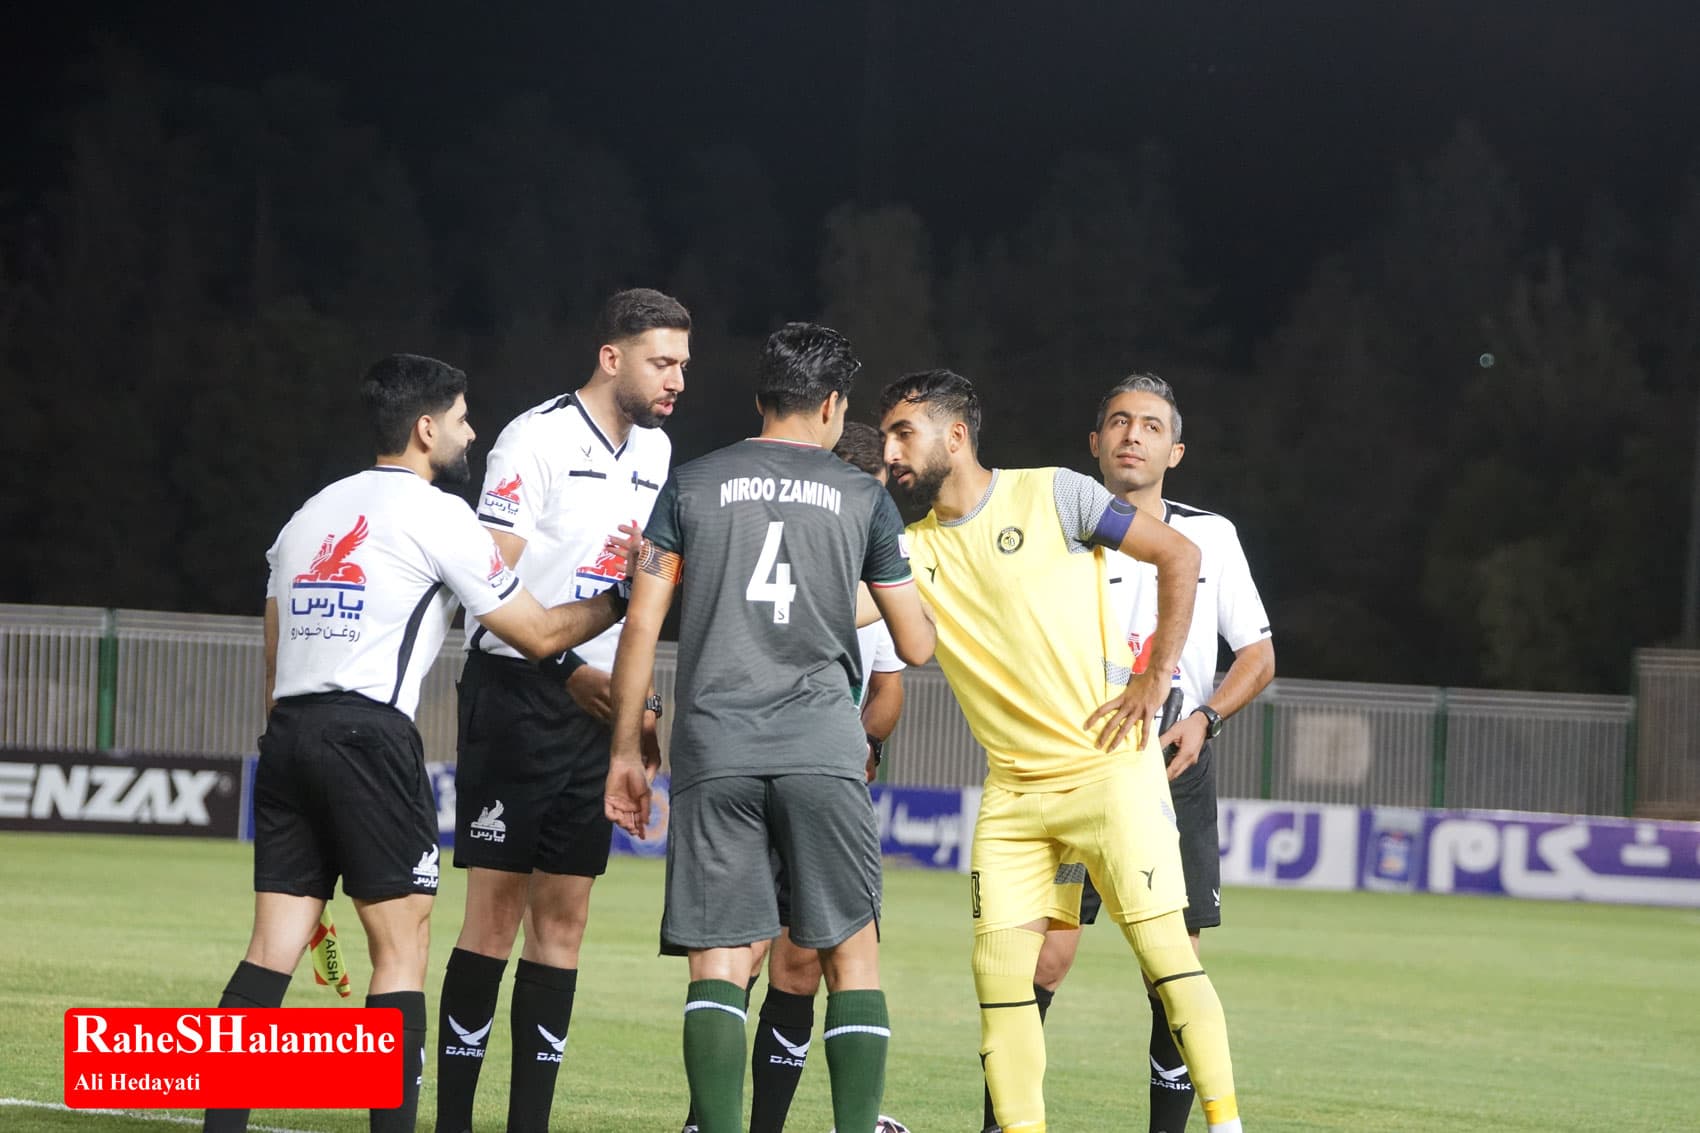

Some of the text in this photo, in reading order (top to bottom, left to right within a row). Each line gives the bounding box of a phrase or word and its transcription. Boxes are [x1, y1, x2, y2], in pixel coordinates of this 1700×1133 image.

[484, 498, 519, 515] پارس
[720, 477, 841, 515] NIROO ZAMINI
[746, 521, 796, 624] 4
[291, 591, 364, 620] پارس
[290, 622, 361, 642] روغن خودرو
[470, 828, 506, 843] پارس
